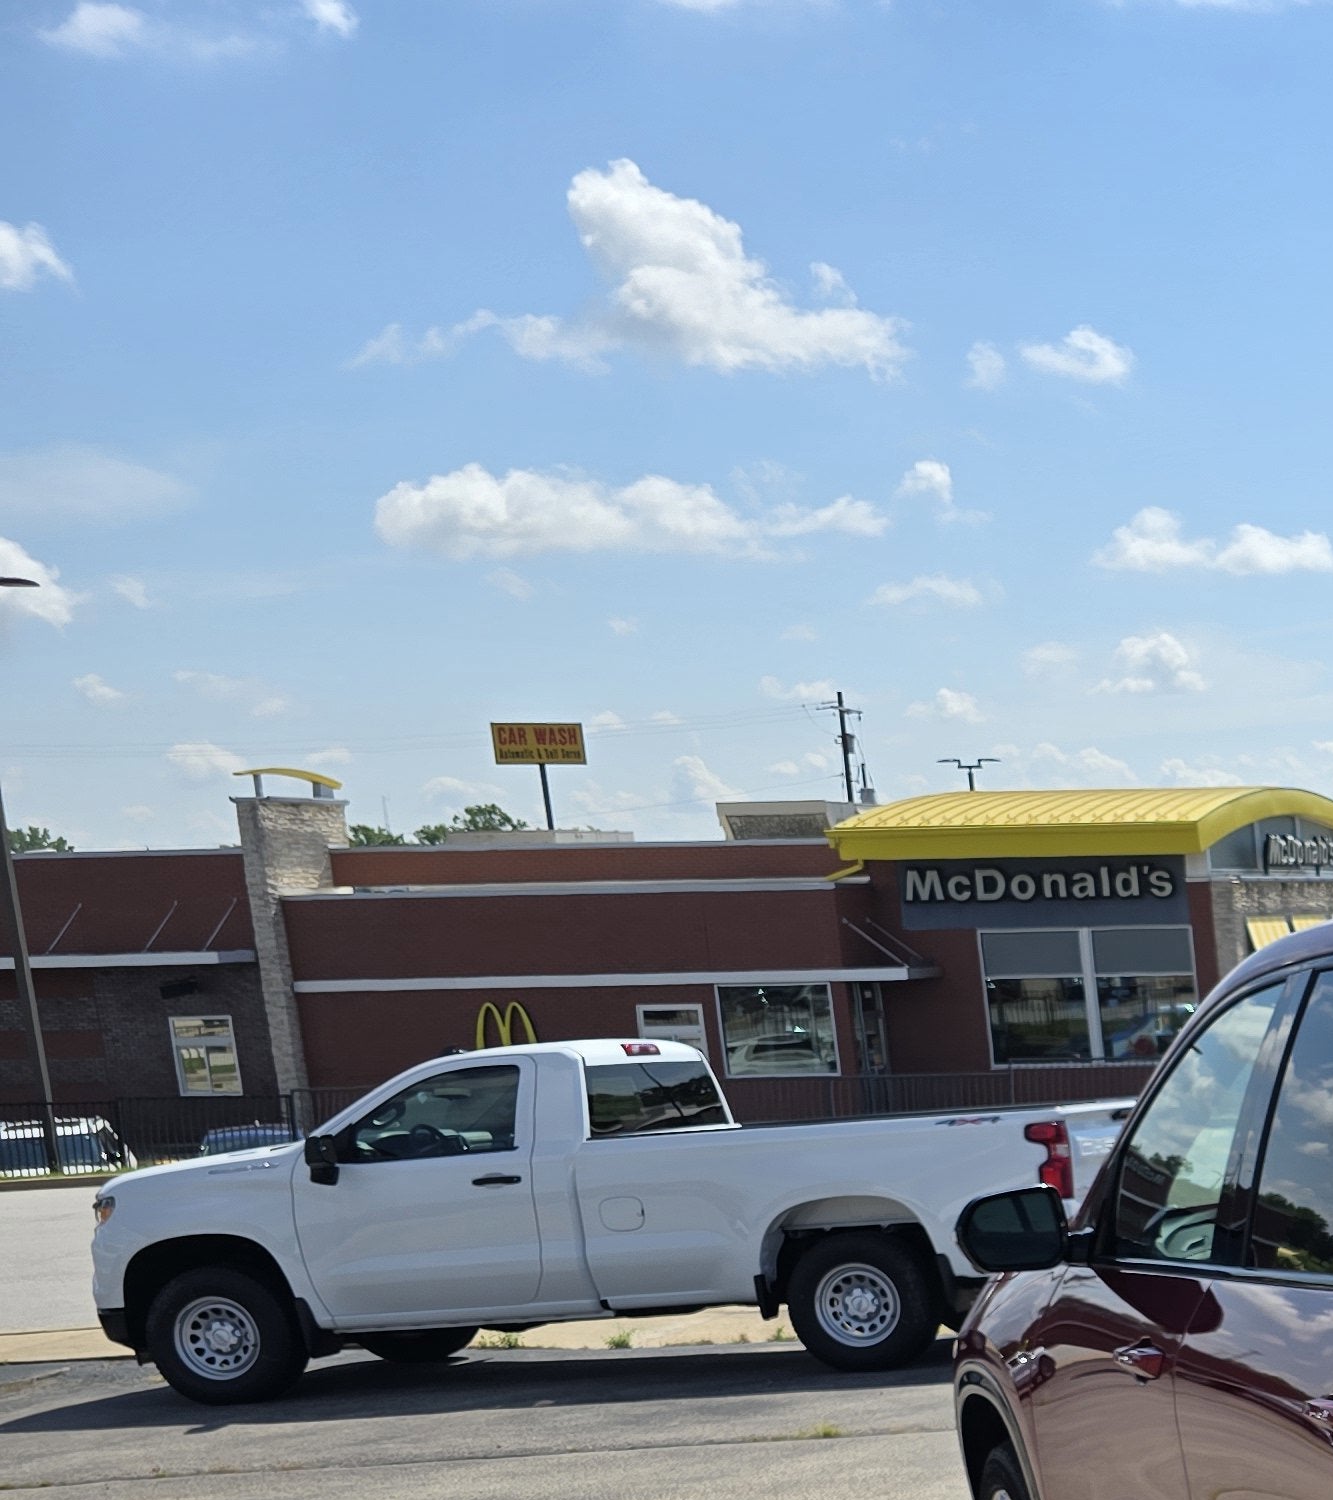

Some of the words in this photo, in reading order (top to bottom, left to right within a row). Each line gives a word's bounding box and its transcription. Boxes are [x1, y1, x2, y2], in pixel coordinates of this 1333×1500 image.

[497, 727, 527, 746] CAR
[533, 727, 577, 746] WASH
[905, 865, 1174, 902] McDonald's
